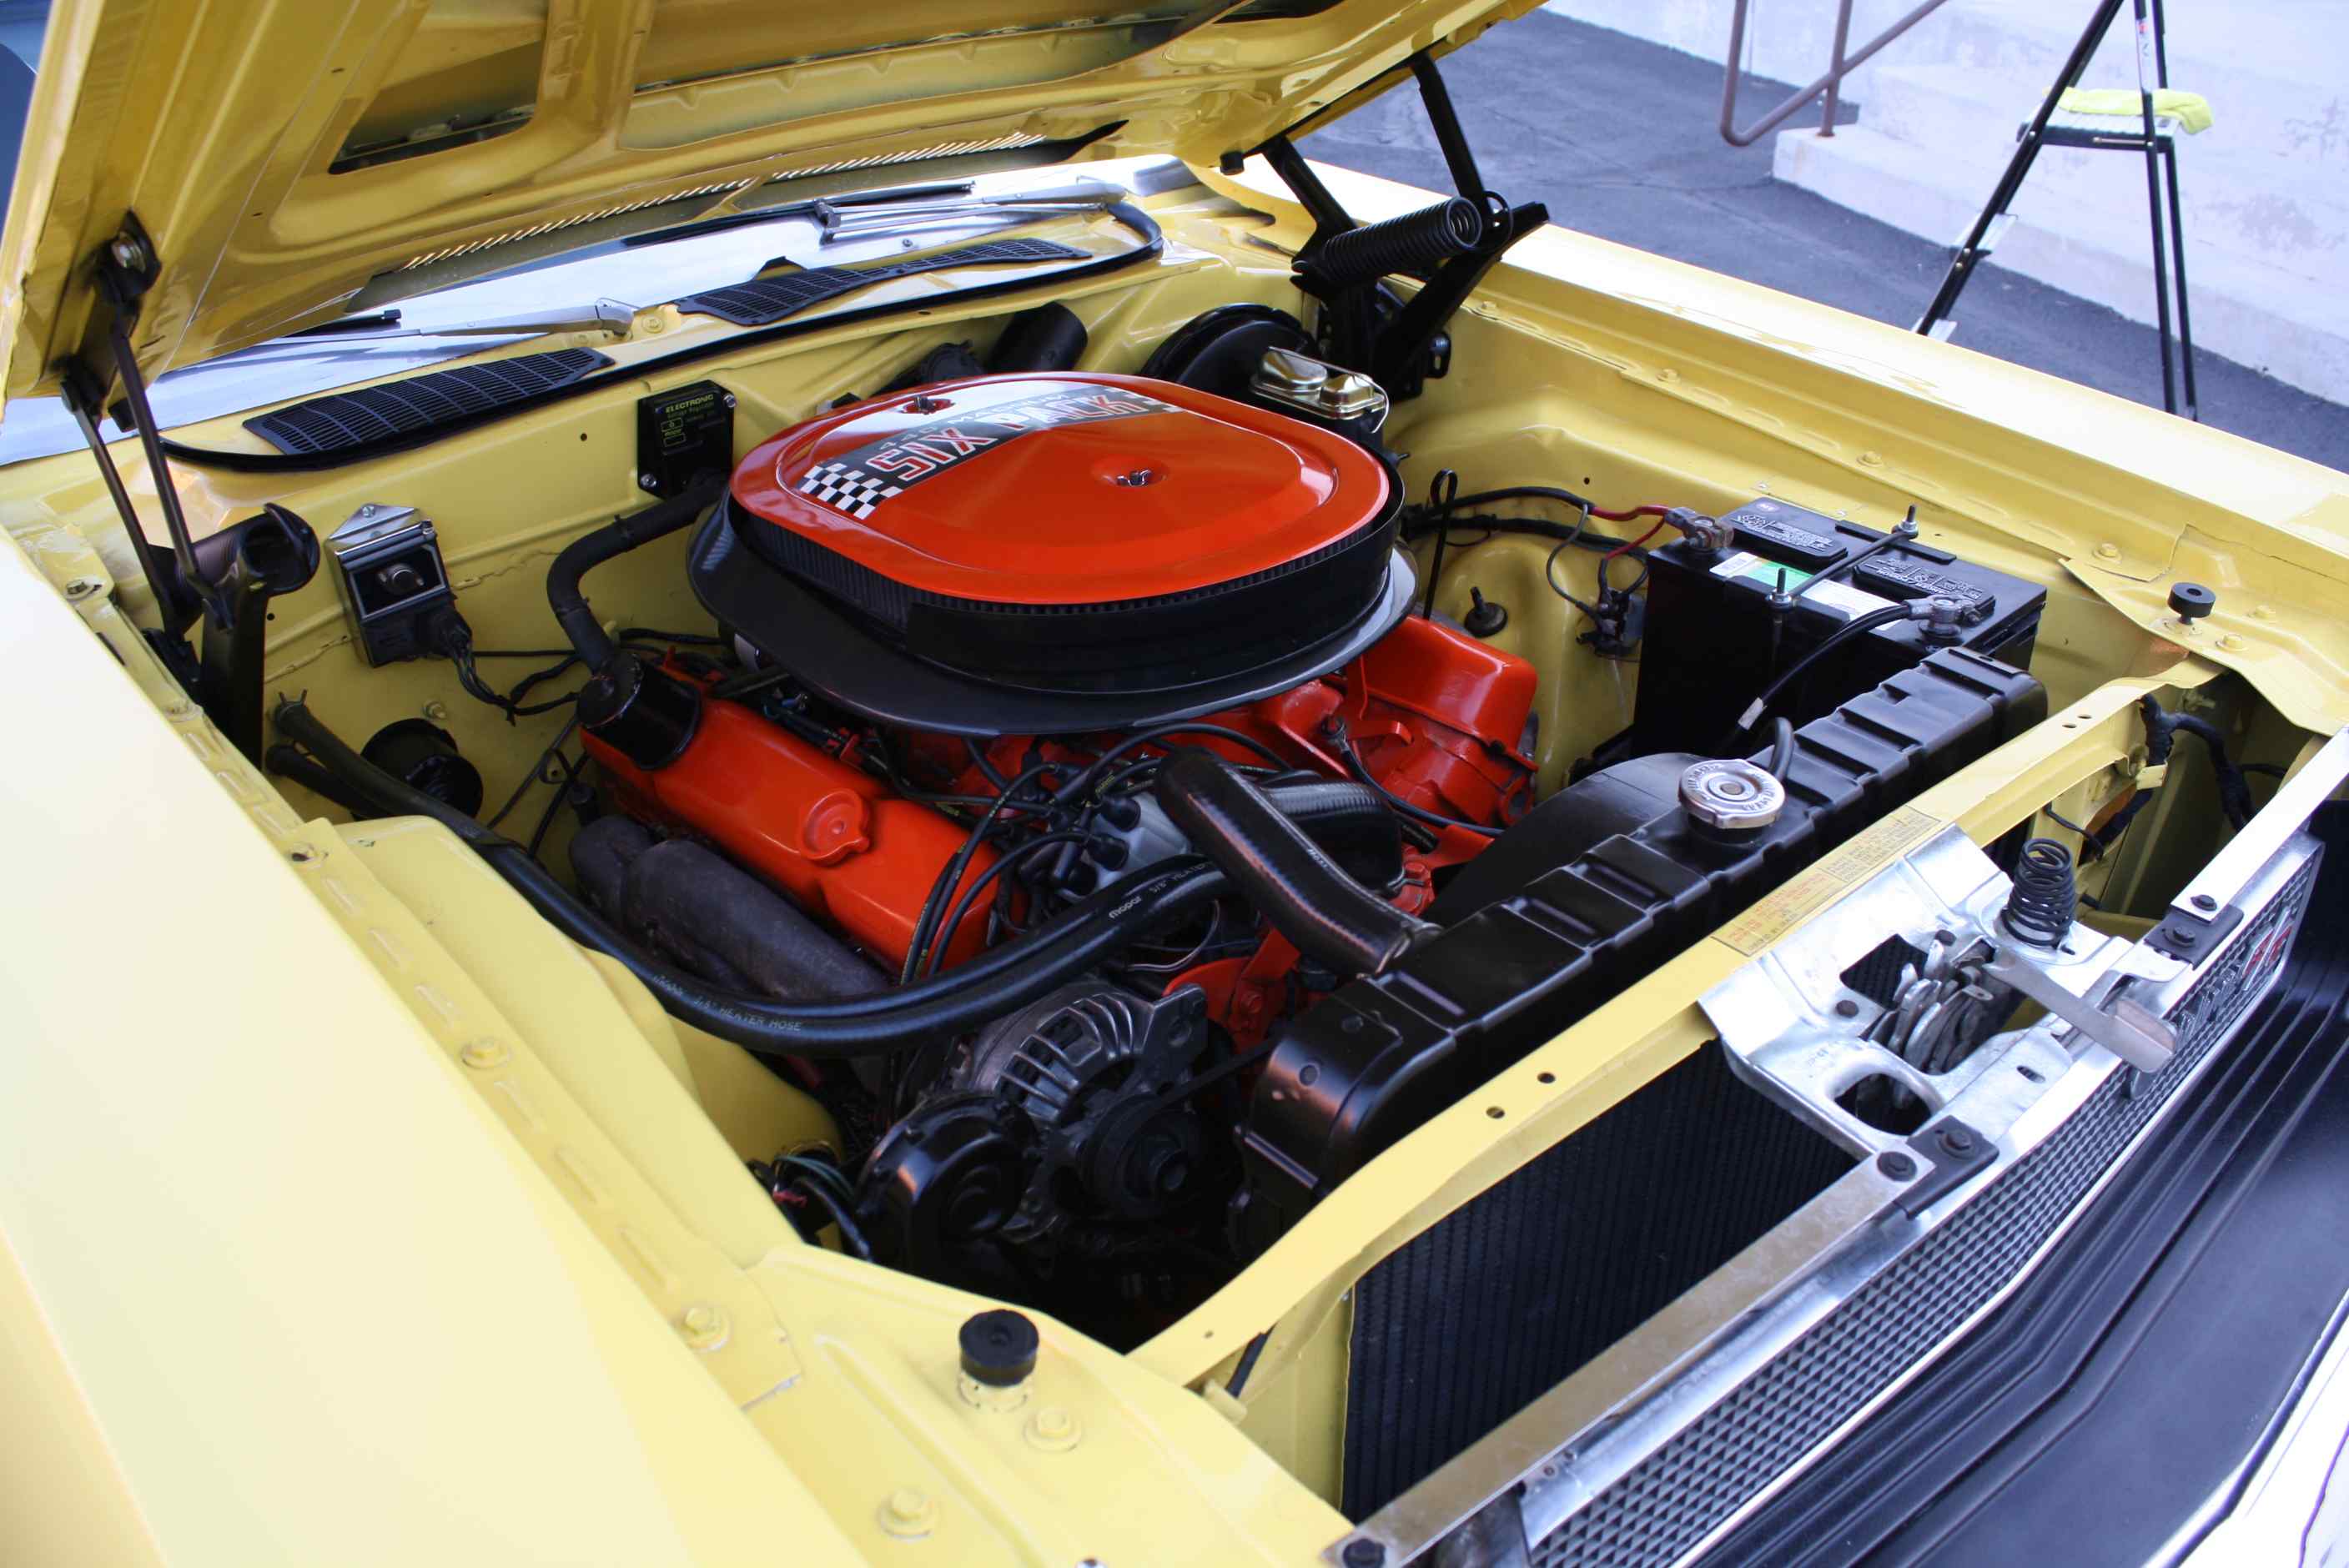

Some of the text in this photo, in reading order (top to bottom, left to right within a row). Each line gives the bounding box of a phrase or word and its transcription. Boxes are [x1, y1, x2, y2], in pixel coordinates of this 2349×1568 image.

[665, 393, 714, 414] ELECTRONIC
[865, 395, 1149, 481] SIX PACK
[880, 426, 938, 450] 440
[768, 1019, 802, 1032] HOSE
